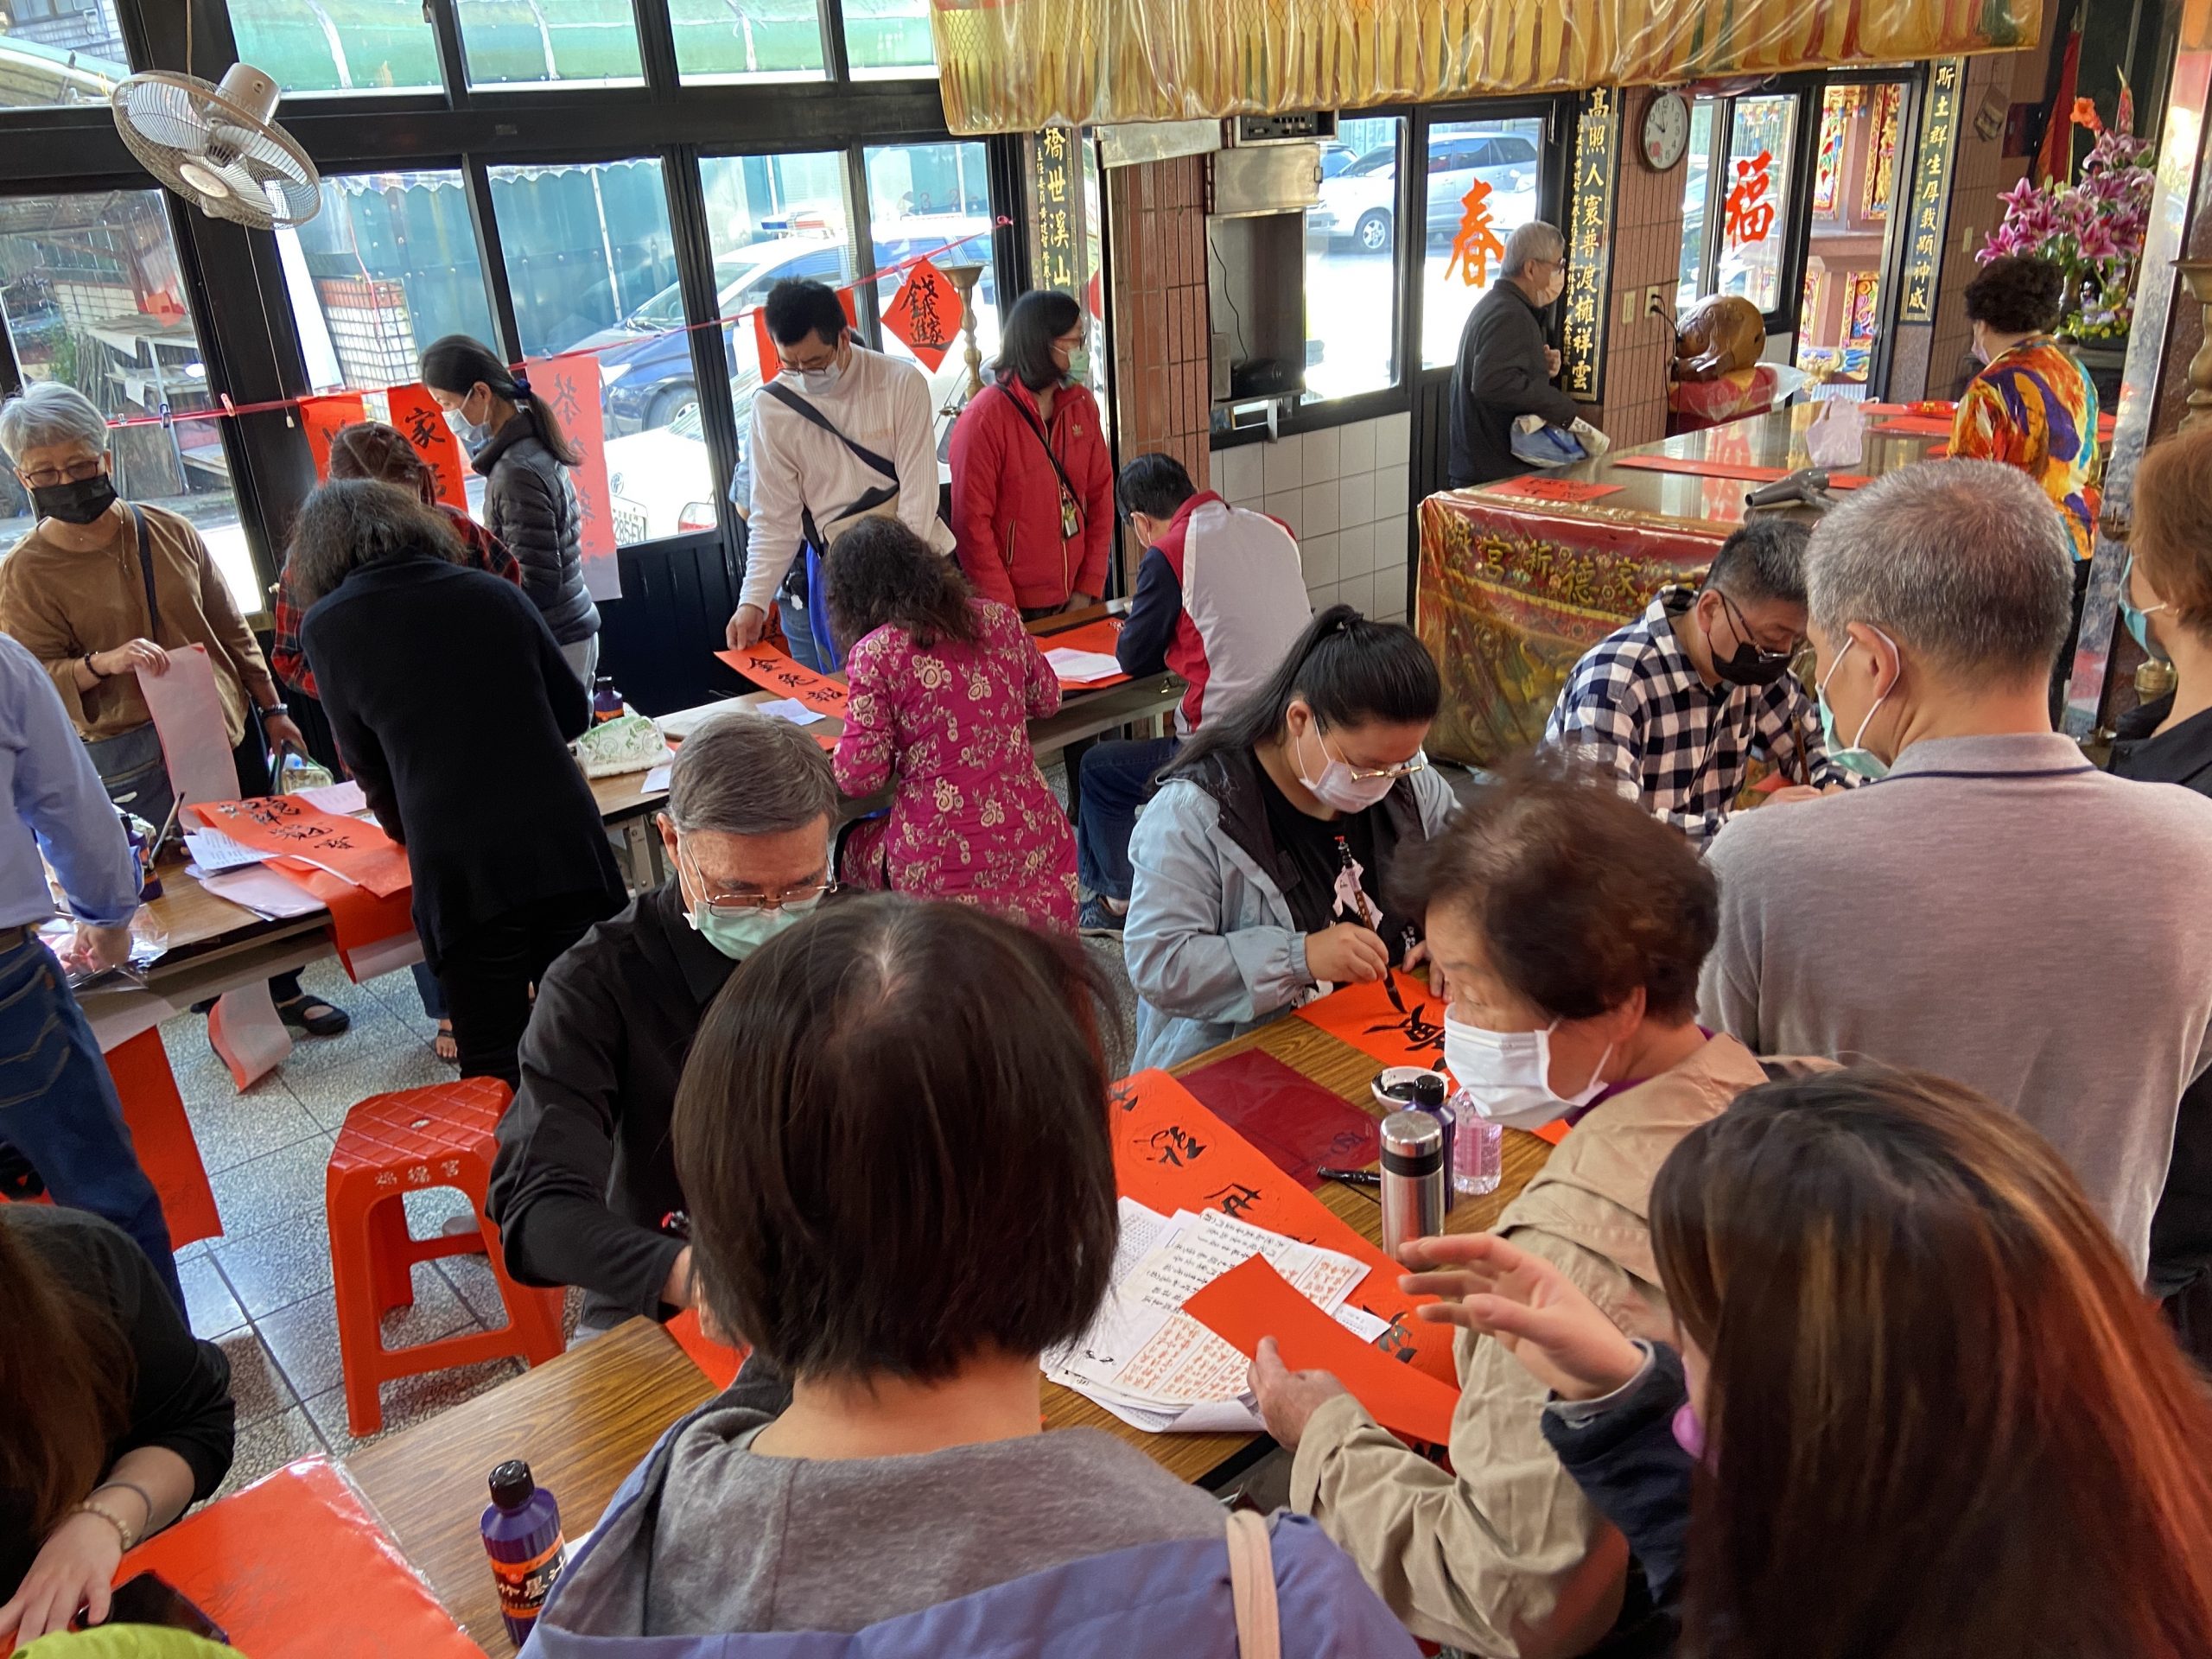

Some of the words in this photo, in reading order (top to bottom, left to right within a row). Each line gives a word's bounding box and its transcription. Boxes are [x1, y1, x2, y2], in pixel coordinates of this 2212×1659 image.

[1444, 176, 1504, 289] 春
[1726, 149, 1774, 252] 福
[1909, 57, 1955, 310] 斯土群生厚載顯神威
